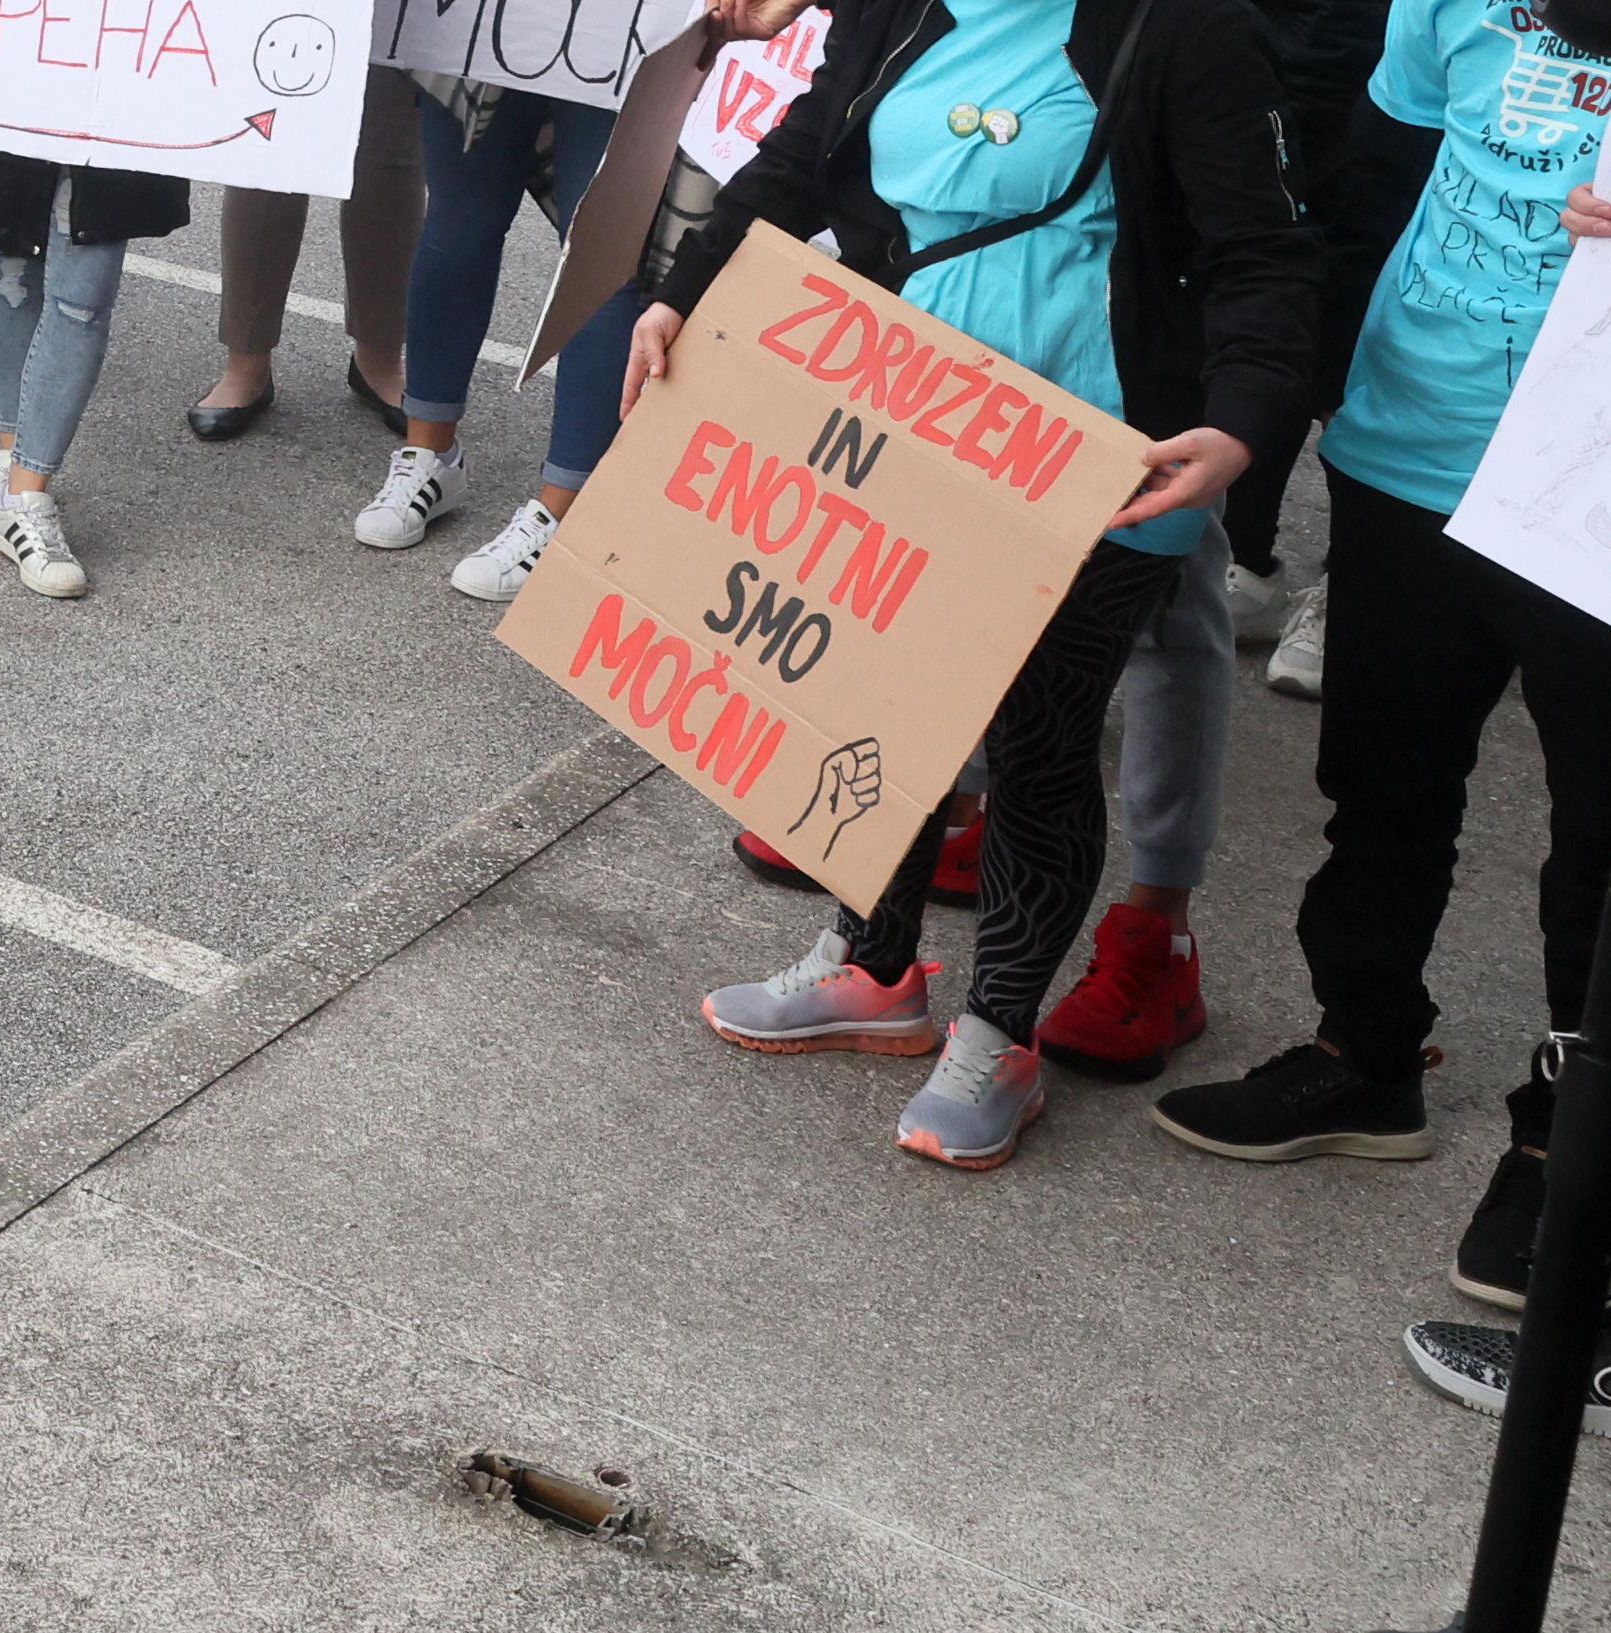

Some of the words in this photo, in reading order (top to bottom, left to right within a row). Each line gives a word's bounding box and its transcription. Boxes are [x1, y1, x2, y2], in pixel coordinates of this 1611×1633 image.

[758, 273, 1083, 502] ZDRUŽENI
[807, 407, 889, 490] IN
[664, 419, 930, 634] ENOTNI
[703, 560, 832, 683] SMO
[568, 593, 787, 800] MOČNI
